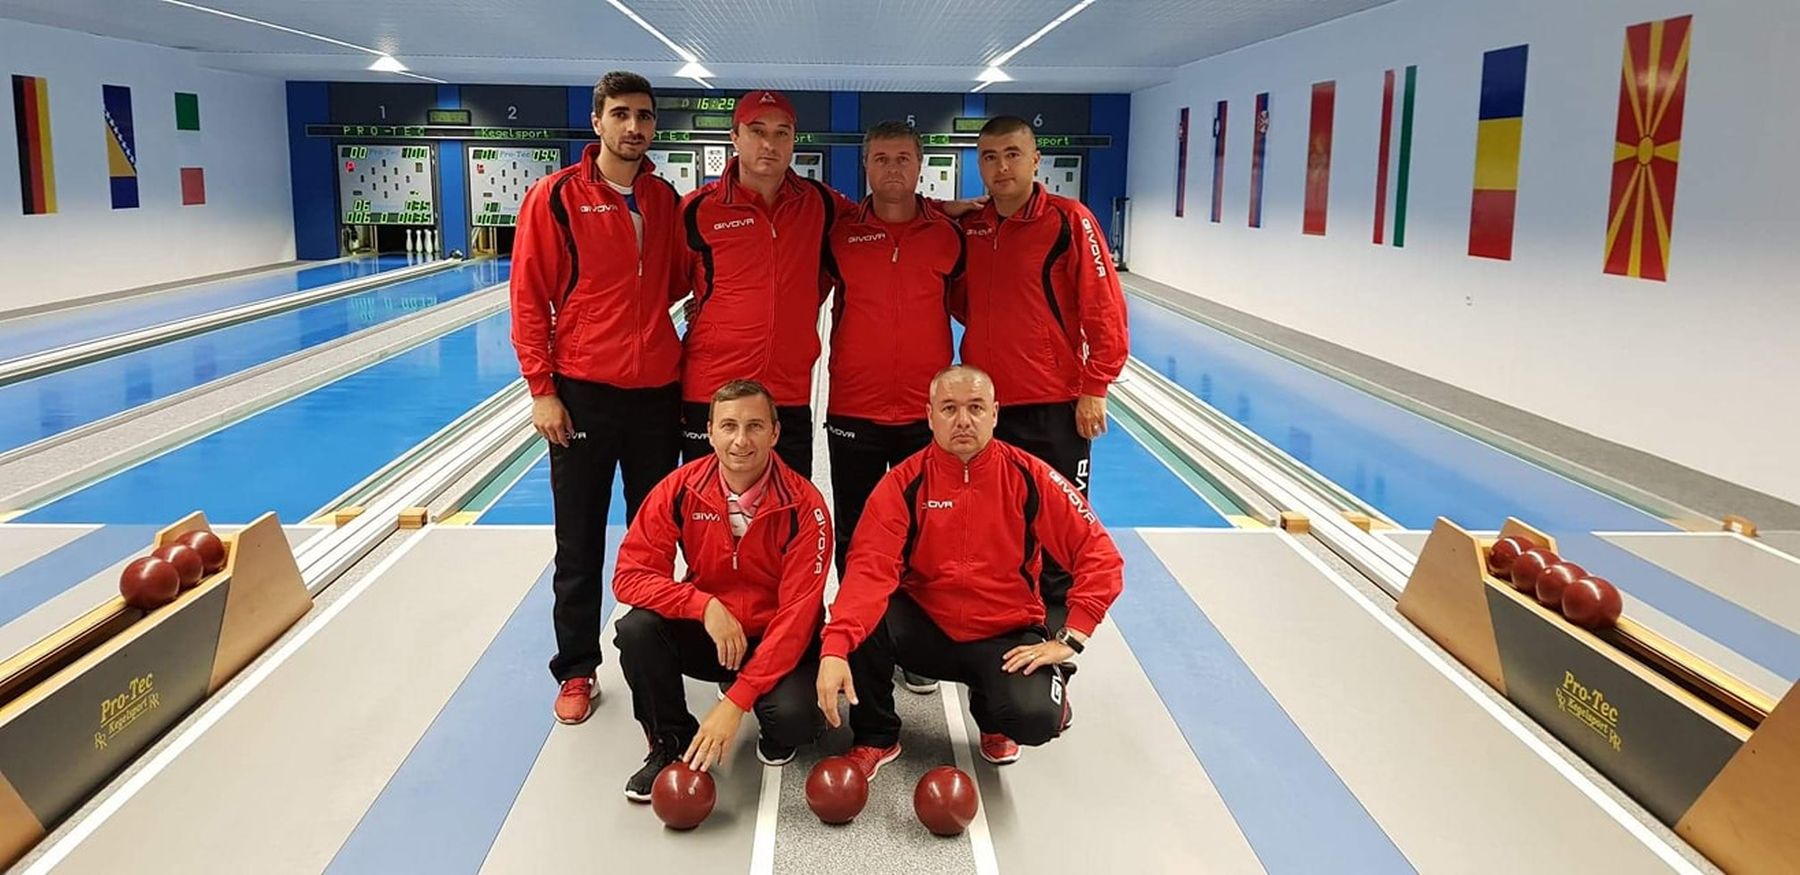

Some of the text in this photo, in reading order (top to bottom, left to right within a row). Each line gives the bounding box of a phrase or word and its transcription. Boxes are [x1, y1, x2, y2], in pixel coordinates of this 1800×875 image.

[697, 98, 735, 110] 16:29
[379, 105, 386, 119] 1
[507, 105, 517, 120] 2
[906, 115, 916, 127] 5
[1033, 114, 1044, 127] 6
[481, 129, 549, 139] Kegelsport
[714, 218, 754, 230] GIVOVA
[1082, 218, 1106, 277] GIVOVA
[1049, 471, 1095, 525] GIVOVA
[814, 508, 825, 574] GIVOVA
[100, 673, 153, 723] Pro-Tec
[1563, 671, 1618, 722] Pro-Tec
